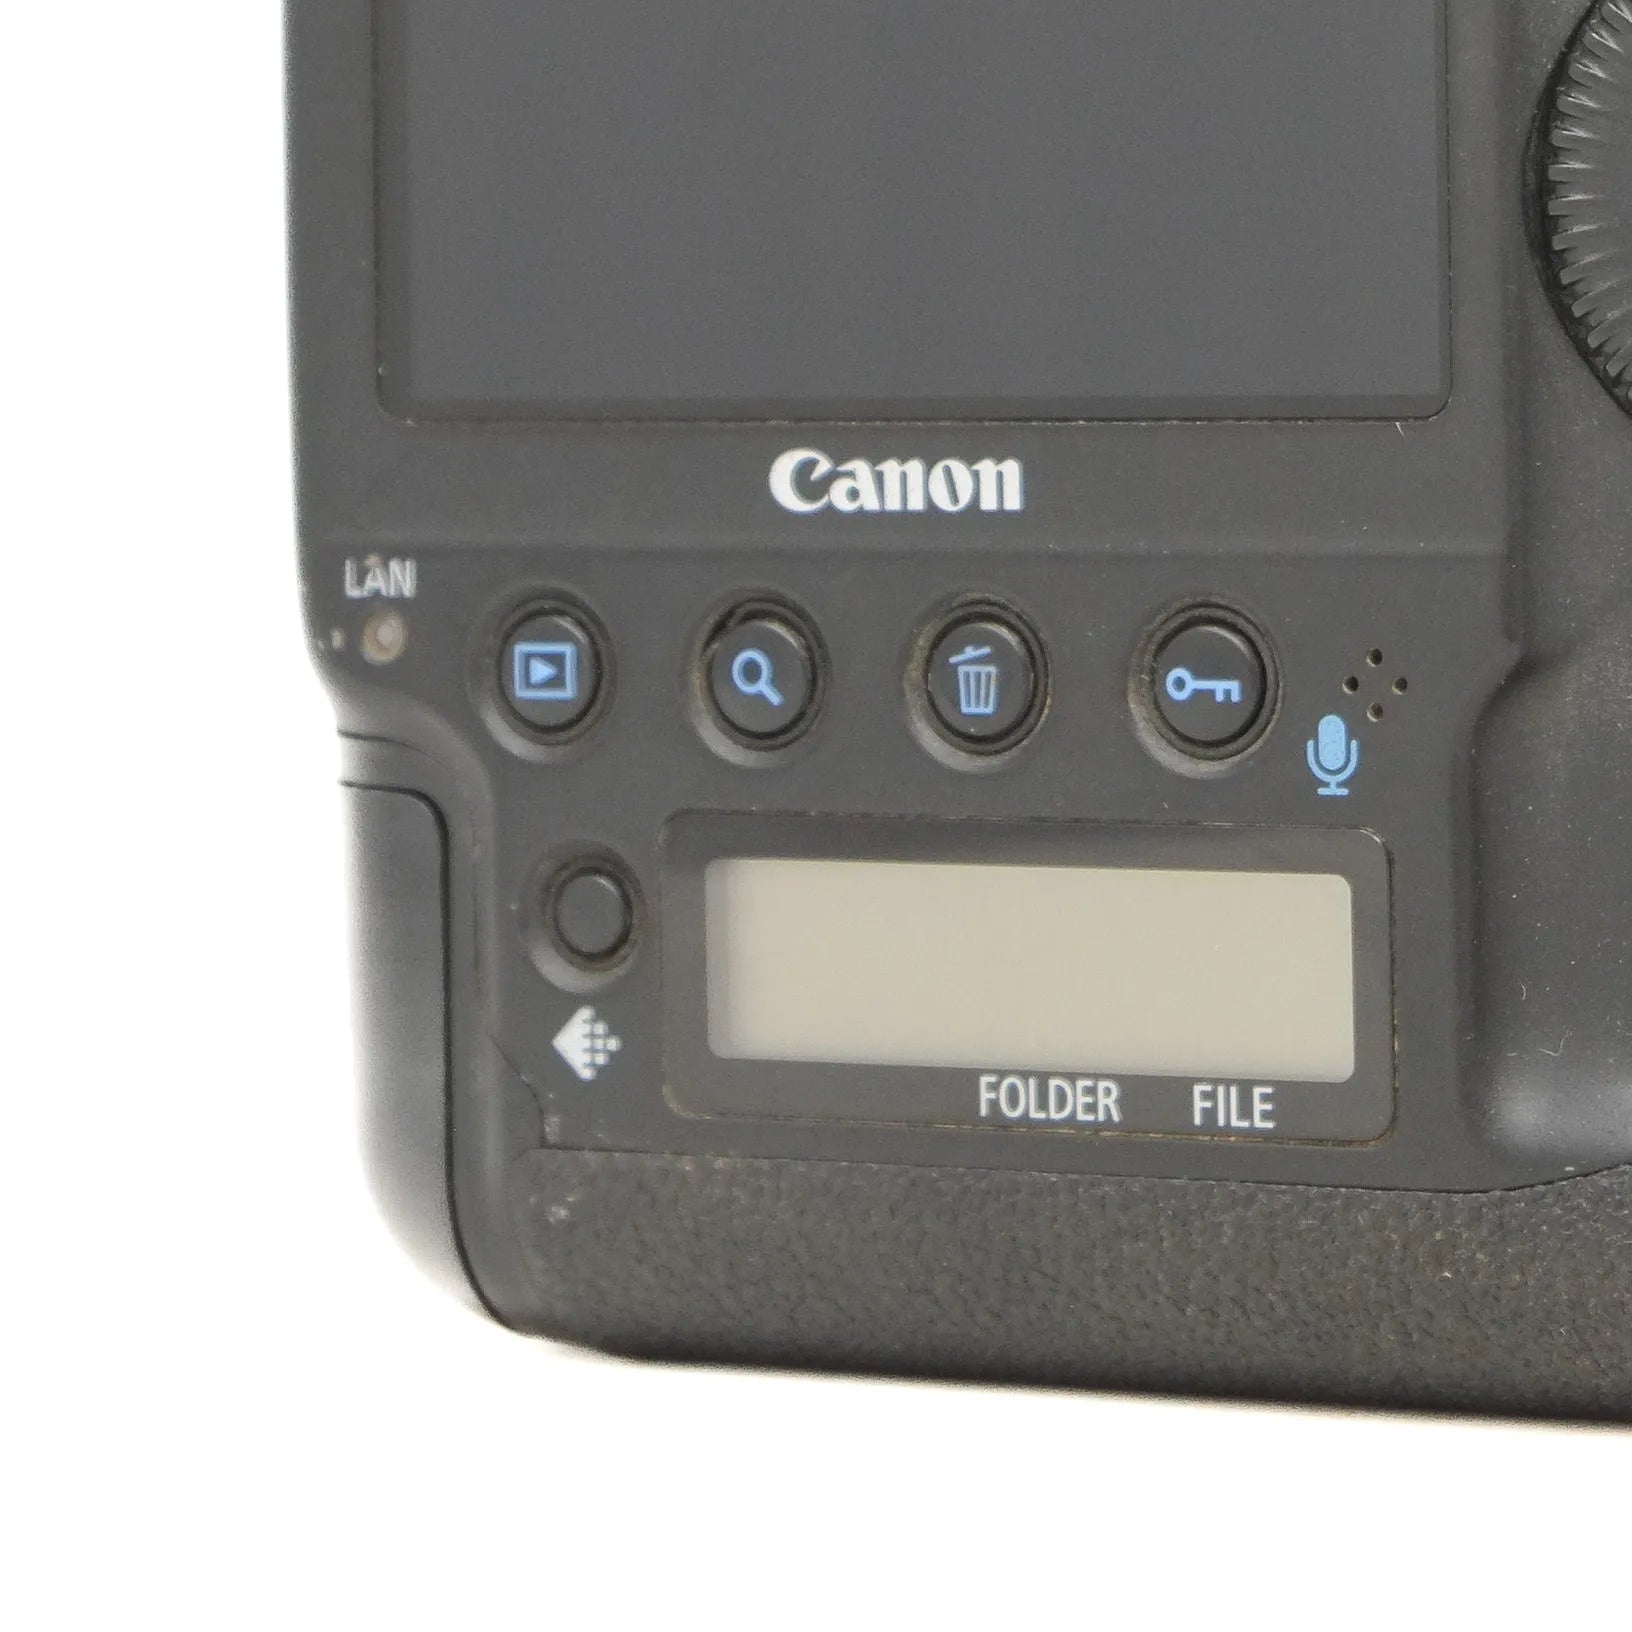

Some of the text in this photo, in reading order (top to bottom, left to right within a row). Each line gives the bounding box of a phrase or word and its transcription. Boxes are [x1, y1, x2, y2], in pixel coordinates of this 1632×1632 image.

[769, 447, 1024, 513] Canon
[344, 555, 417, 600] LAN
[979, 1074, 1277, 1129] FOLDER FILE
